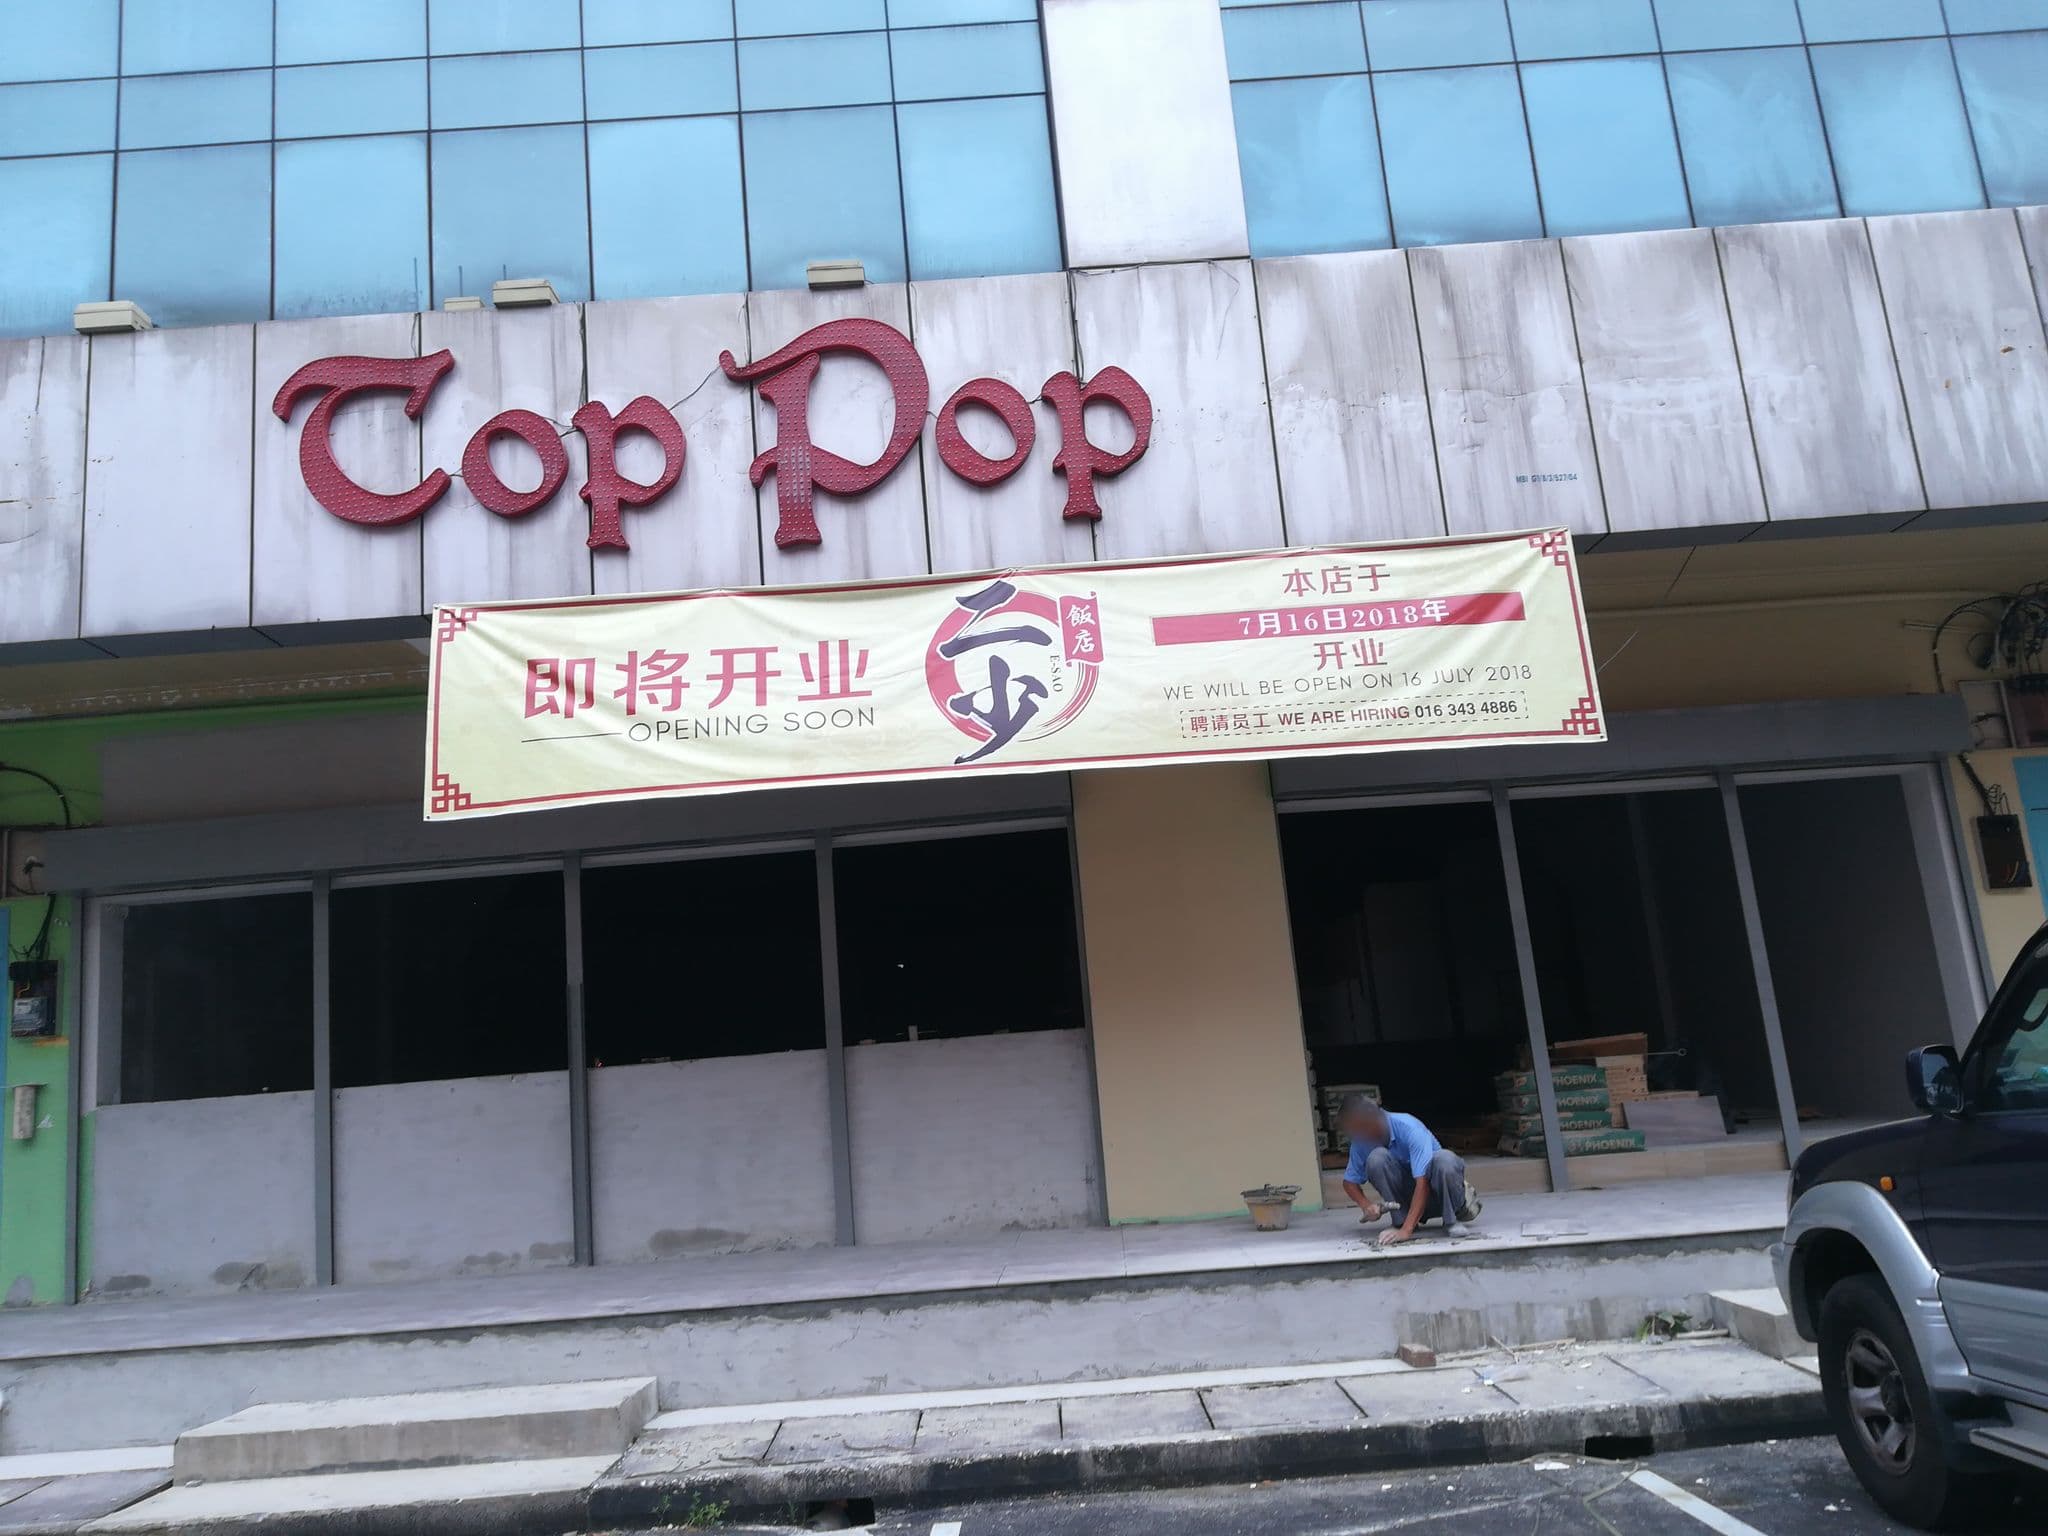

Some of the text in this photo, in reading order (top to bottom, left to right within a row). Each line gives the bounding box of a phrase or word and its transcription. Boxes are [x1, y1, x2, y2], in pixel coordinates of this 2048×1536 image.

[272, 318, 1154, 551] Top Pop
[1282, 563, 1390, 597] 本店于
[1066, 604, 1096, 655] 飯店
[1238, 599, 1450, 636] 7月16日2018年
[1314, 637, 1388, 671] 开业
[524, 638, 873, 719] 即将开业
[1050, 655, 1063, 692] E-SAO
[1163, 664, 1532, 701] WE WILL BE OPEN ON 16 JULY 2018
[628, 706, 875, 742] OPENING SOON
[1190, 700, 1518, 733] 聘请员工 WE ARE HIRING 016 343 4886
[1557, 1094, 1600, 1106] HOENIX
[1559, 1120, 1602, 1131] HOENIX
